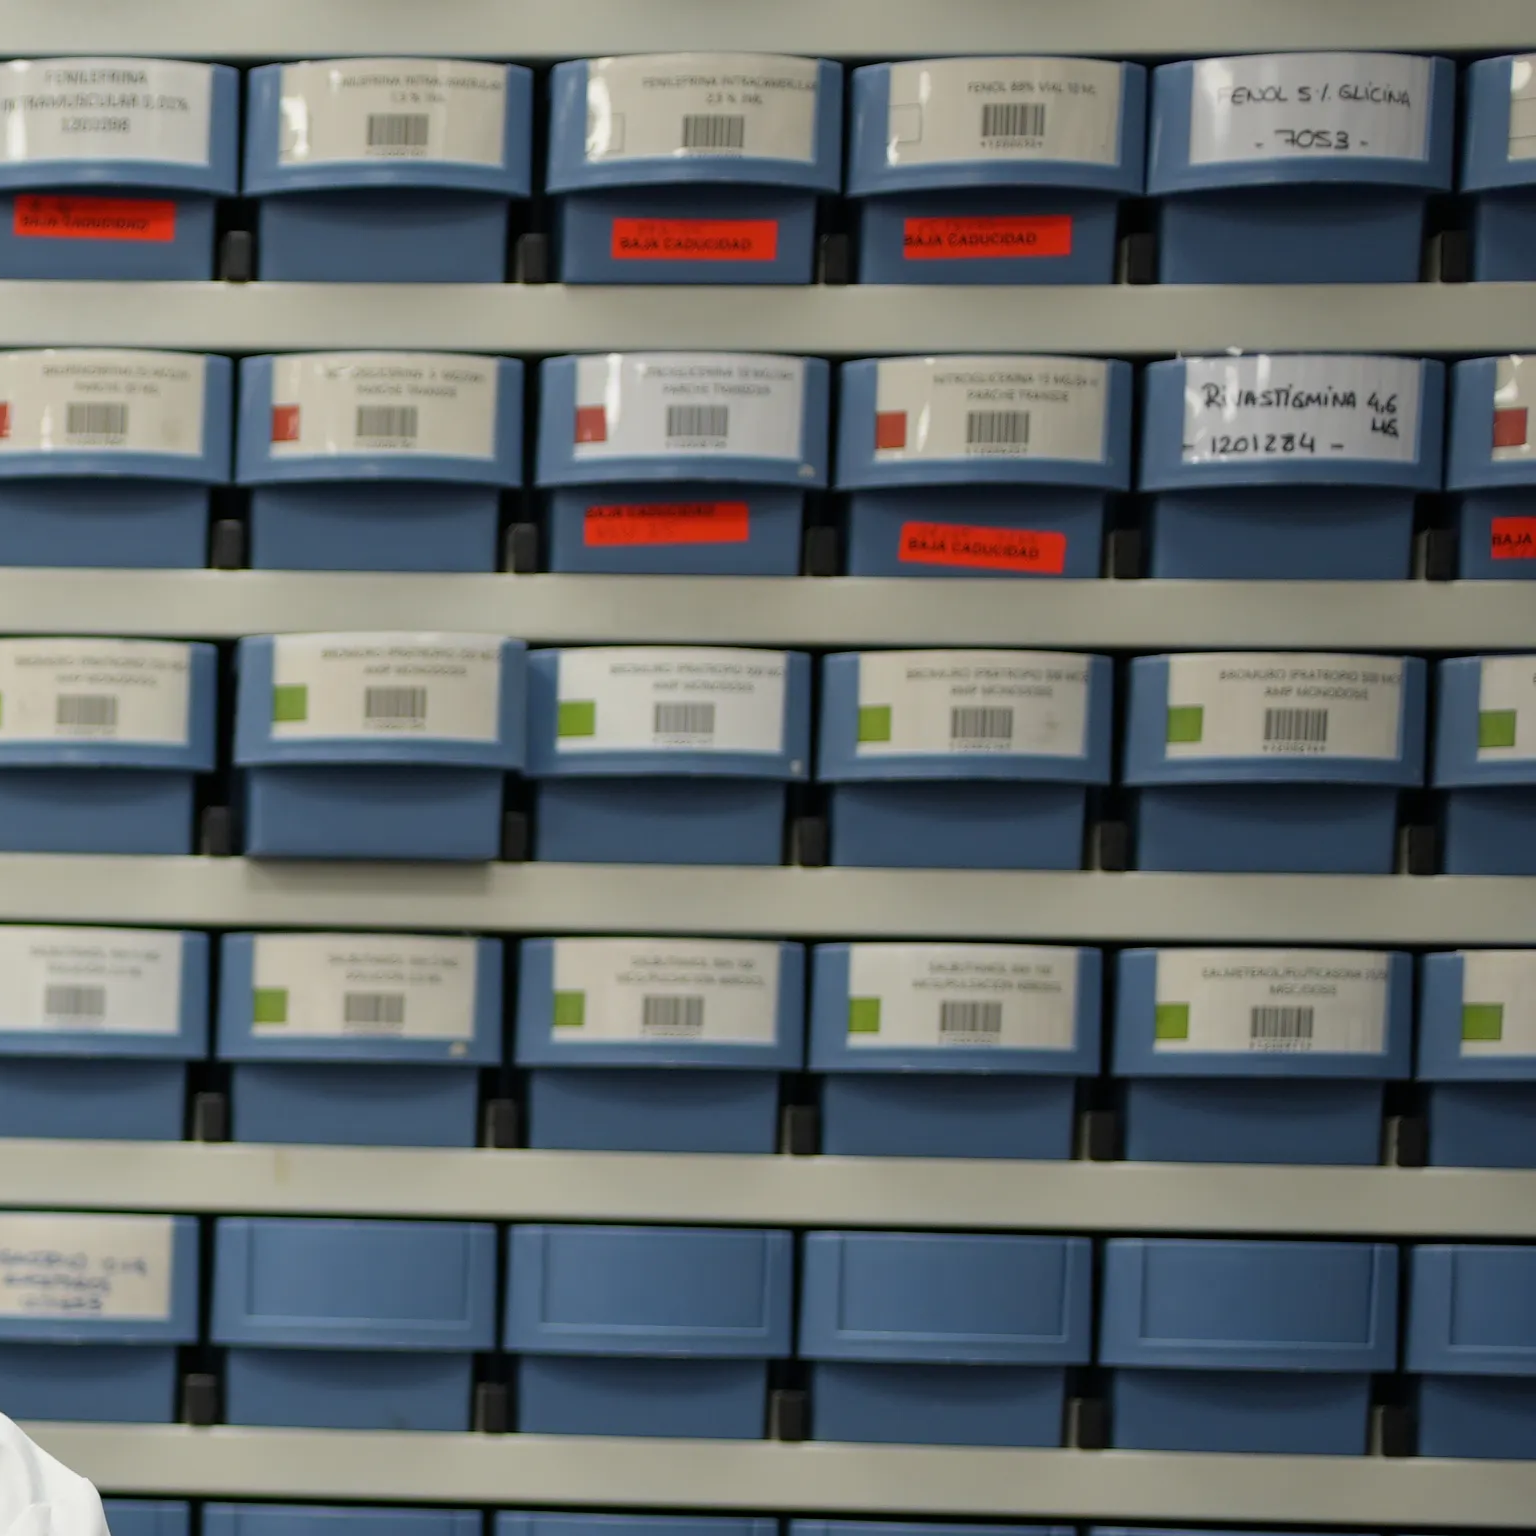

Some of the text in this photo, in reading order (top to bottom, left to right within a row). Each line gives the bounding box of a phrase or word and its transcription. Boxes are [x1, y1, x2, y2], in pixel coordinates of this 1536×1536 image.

[620, 236, 752, 251] BAJA CADUCIDAD
[904, 231, 1037, 247] BAJA CADUCIDAD
[908, 537, 1040, 560] BAJA CADUCIDAD
